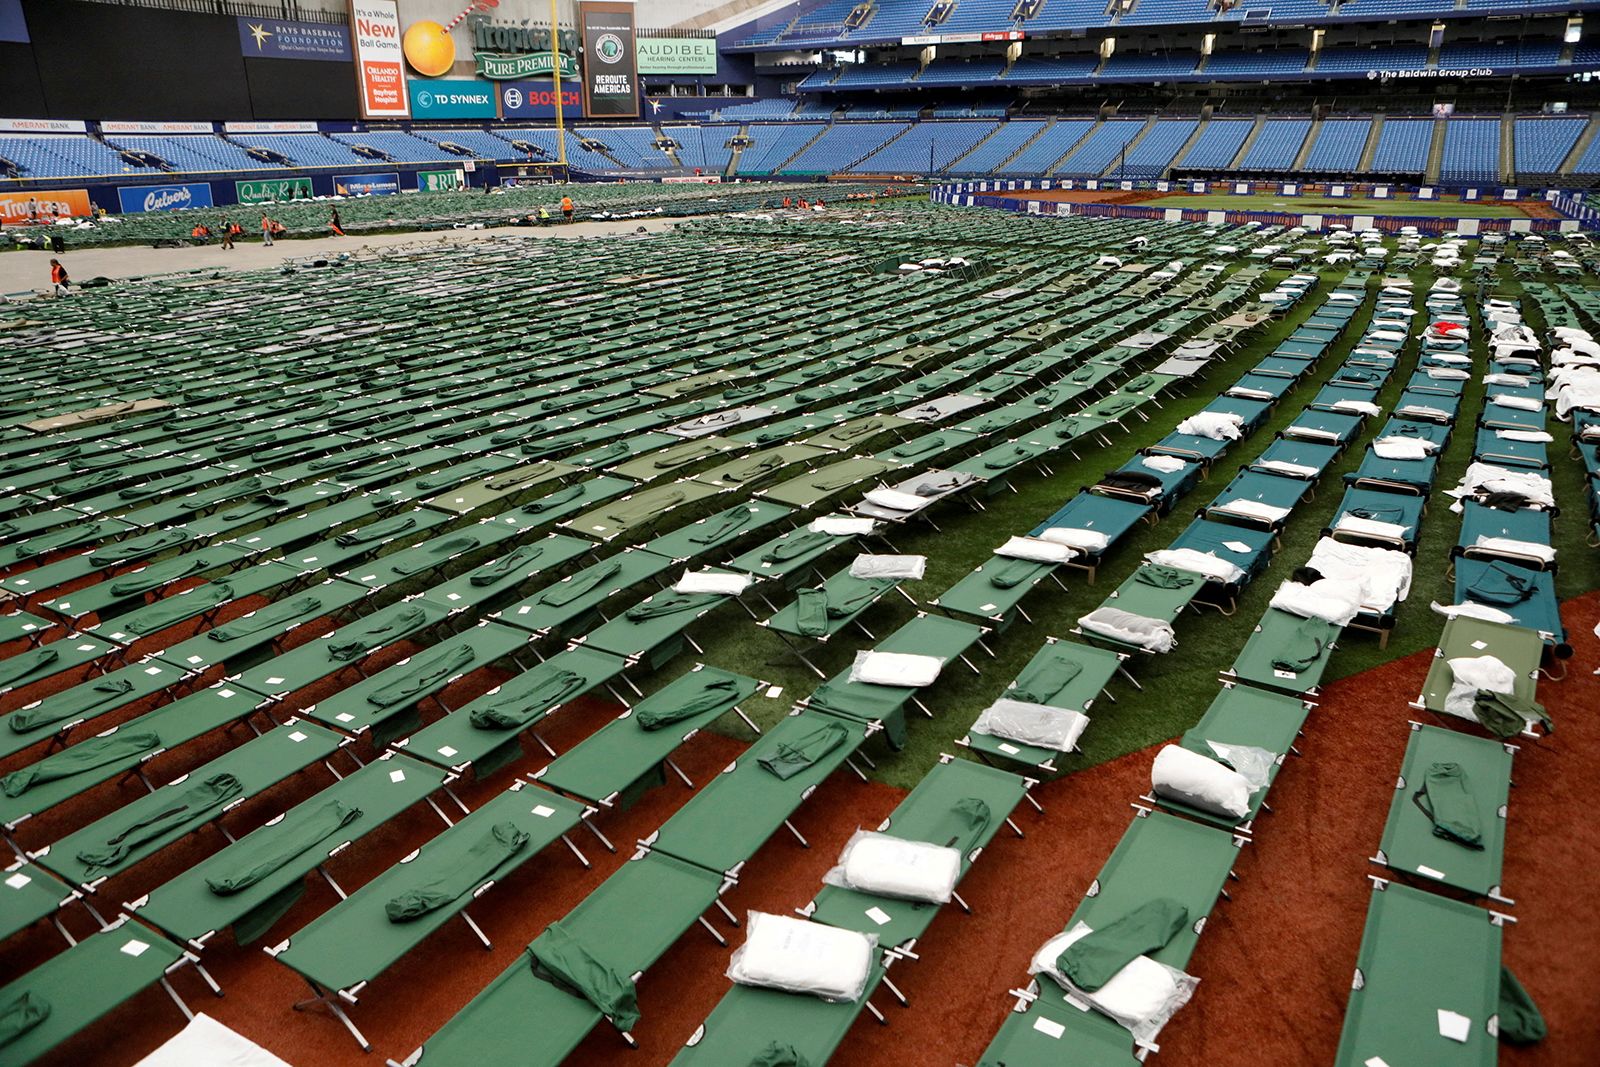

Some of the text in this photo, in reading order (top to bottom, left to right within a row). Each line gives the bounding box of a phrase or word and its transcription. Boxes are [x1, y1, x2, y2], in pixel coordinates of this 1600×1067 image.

[373, 10, 394, 19] Whole
[275, 26, 342, 38] RAYS BASEBALL
[357, 18, 395, 38] New
[277, 36, 343, 47] FOUNDATION
[360, 39, 400, 49] Ball Game.
[638, 45, 715, 55] AUDIBEL
[367, 66, 398, 75] ORLANDO
[484, 60, 515, 75] PURE
[1399, 69, 1437, 78] Baldwin
[1439, 69, 1468, 78] Group
[1470, 68, 1492, 76] Club
[595, 75, 627, 84] REROUTE
[594, 84, 631, 93] AMERICAS
[374, 96, 398, 104] Hospital
[435, 95, 488, 104] TD SYNNEX
[529, 91, 579, 106] BOSCH
[12, 121, 49, 129] AMERANT
[144, 186, 191, 212] Culver's
[0, 198, 72, 219] Troicaa
